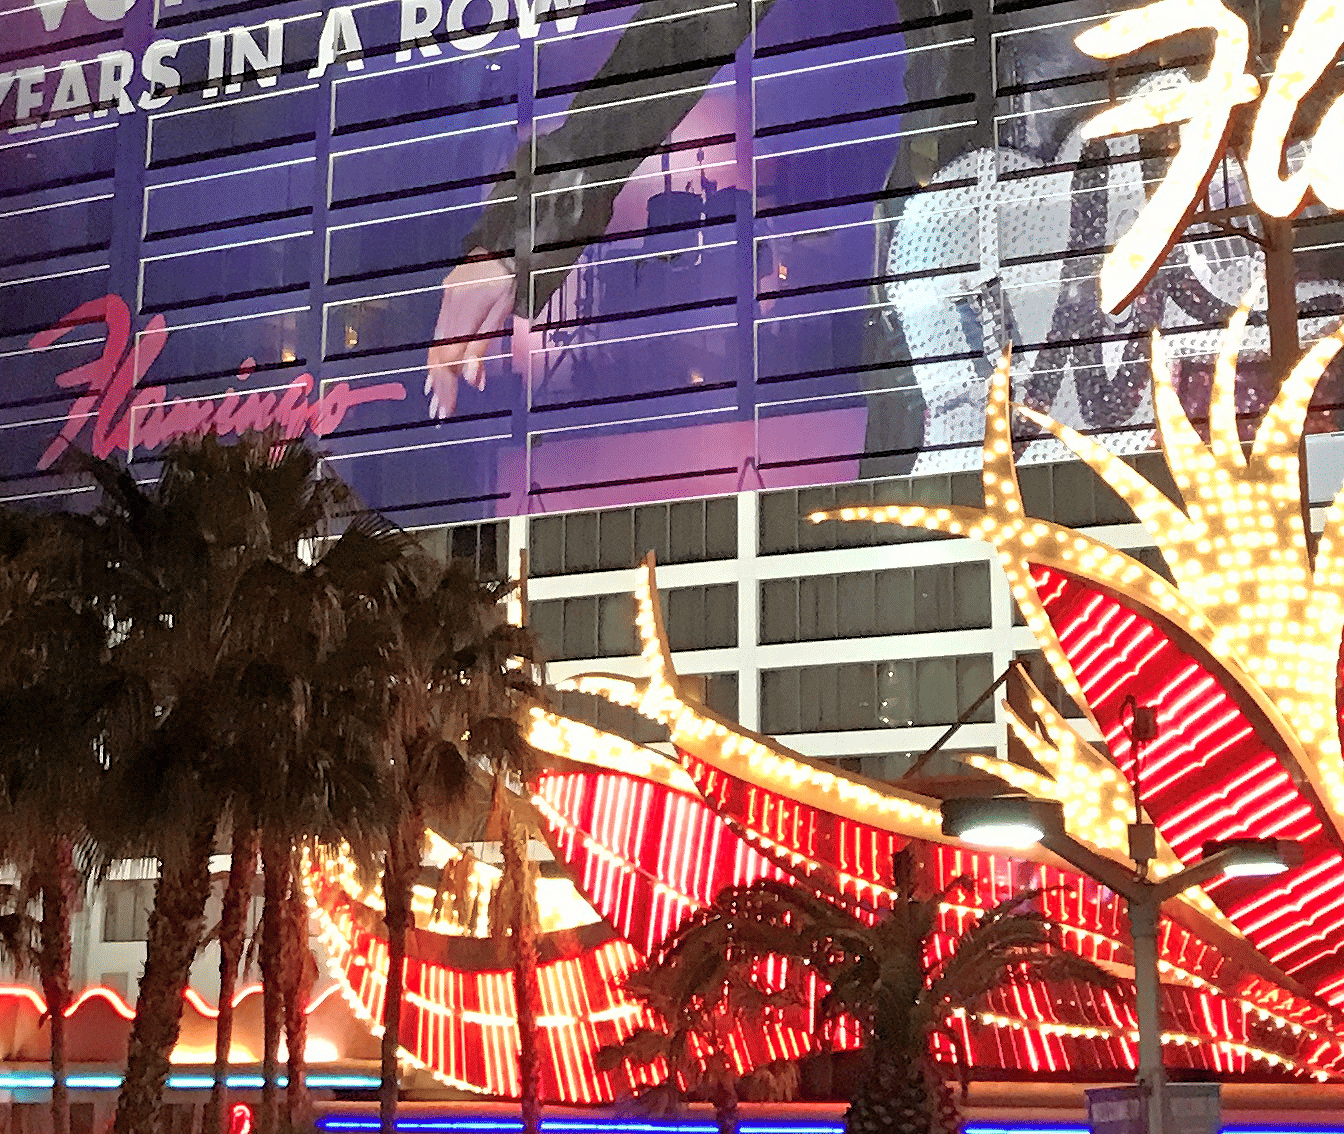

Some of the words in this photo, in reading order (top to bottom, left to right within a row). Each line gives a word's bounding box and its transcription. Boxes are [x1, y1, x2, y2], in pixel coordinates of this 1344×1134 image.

[201, 19, 286, 98] IN
[317, 5, 368, 79] A
[28, 293, 407, 470] Flamingo
